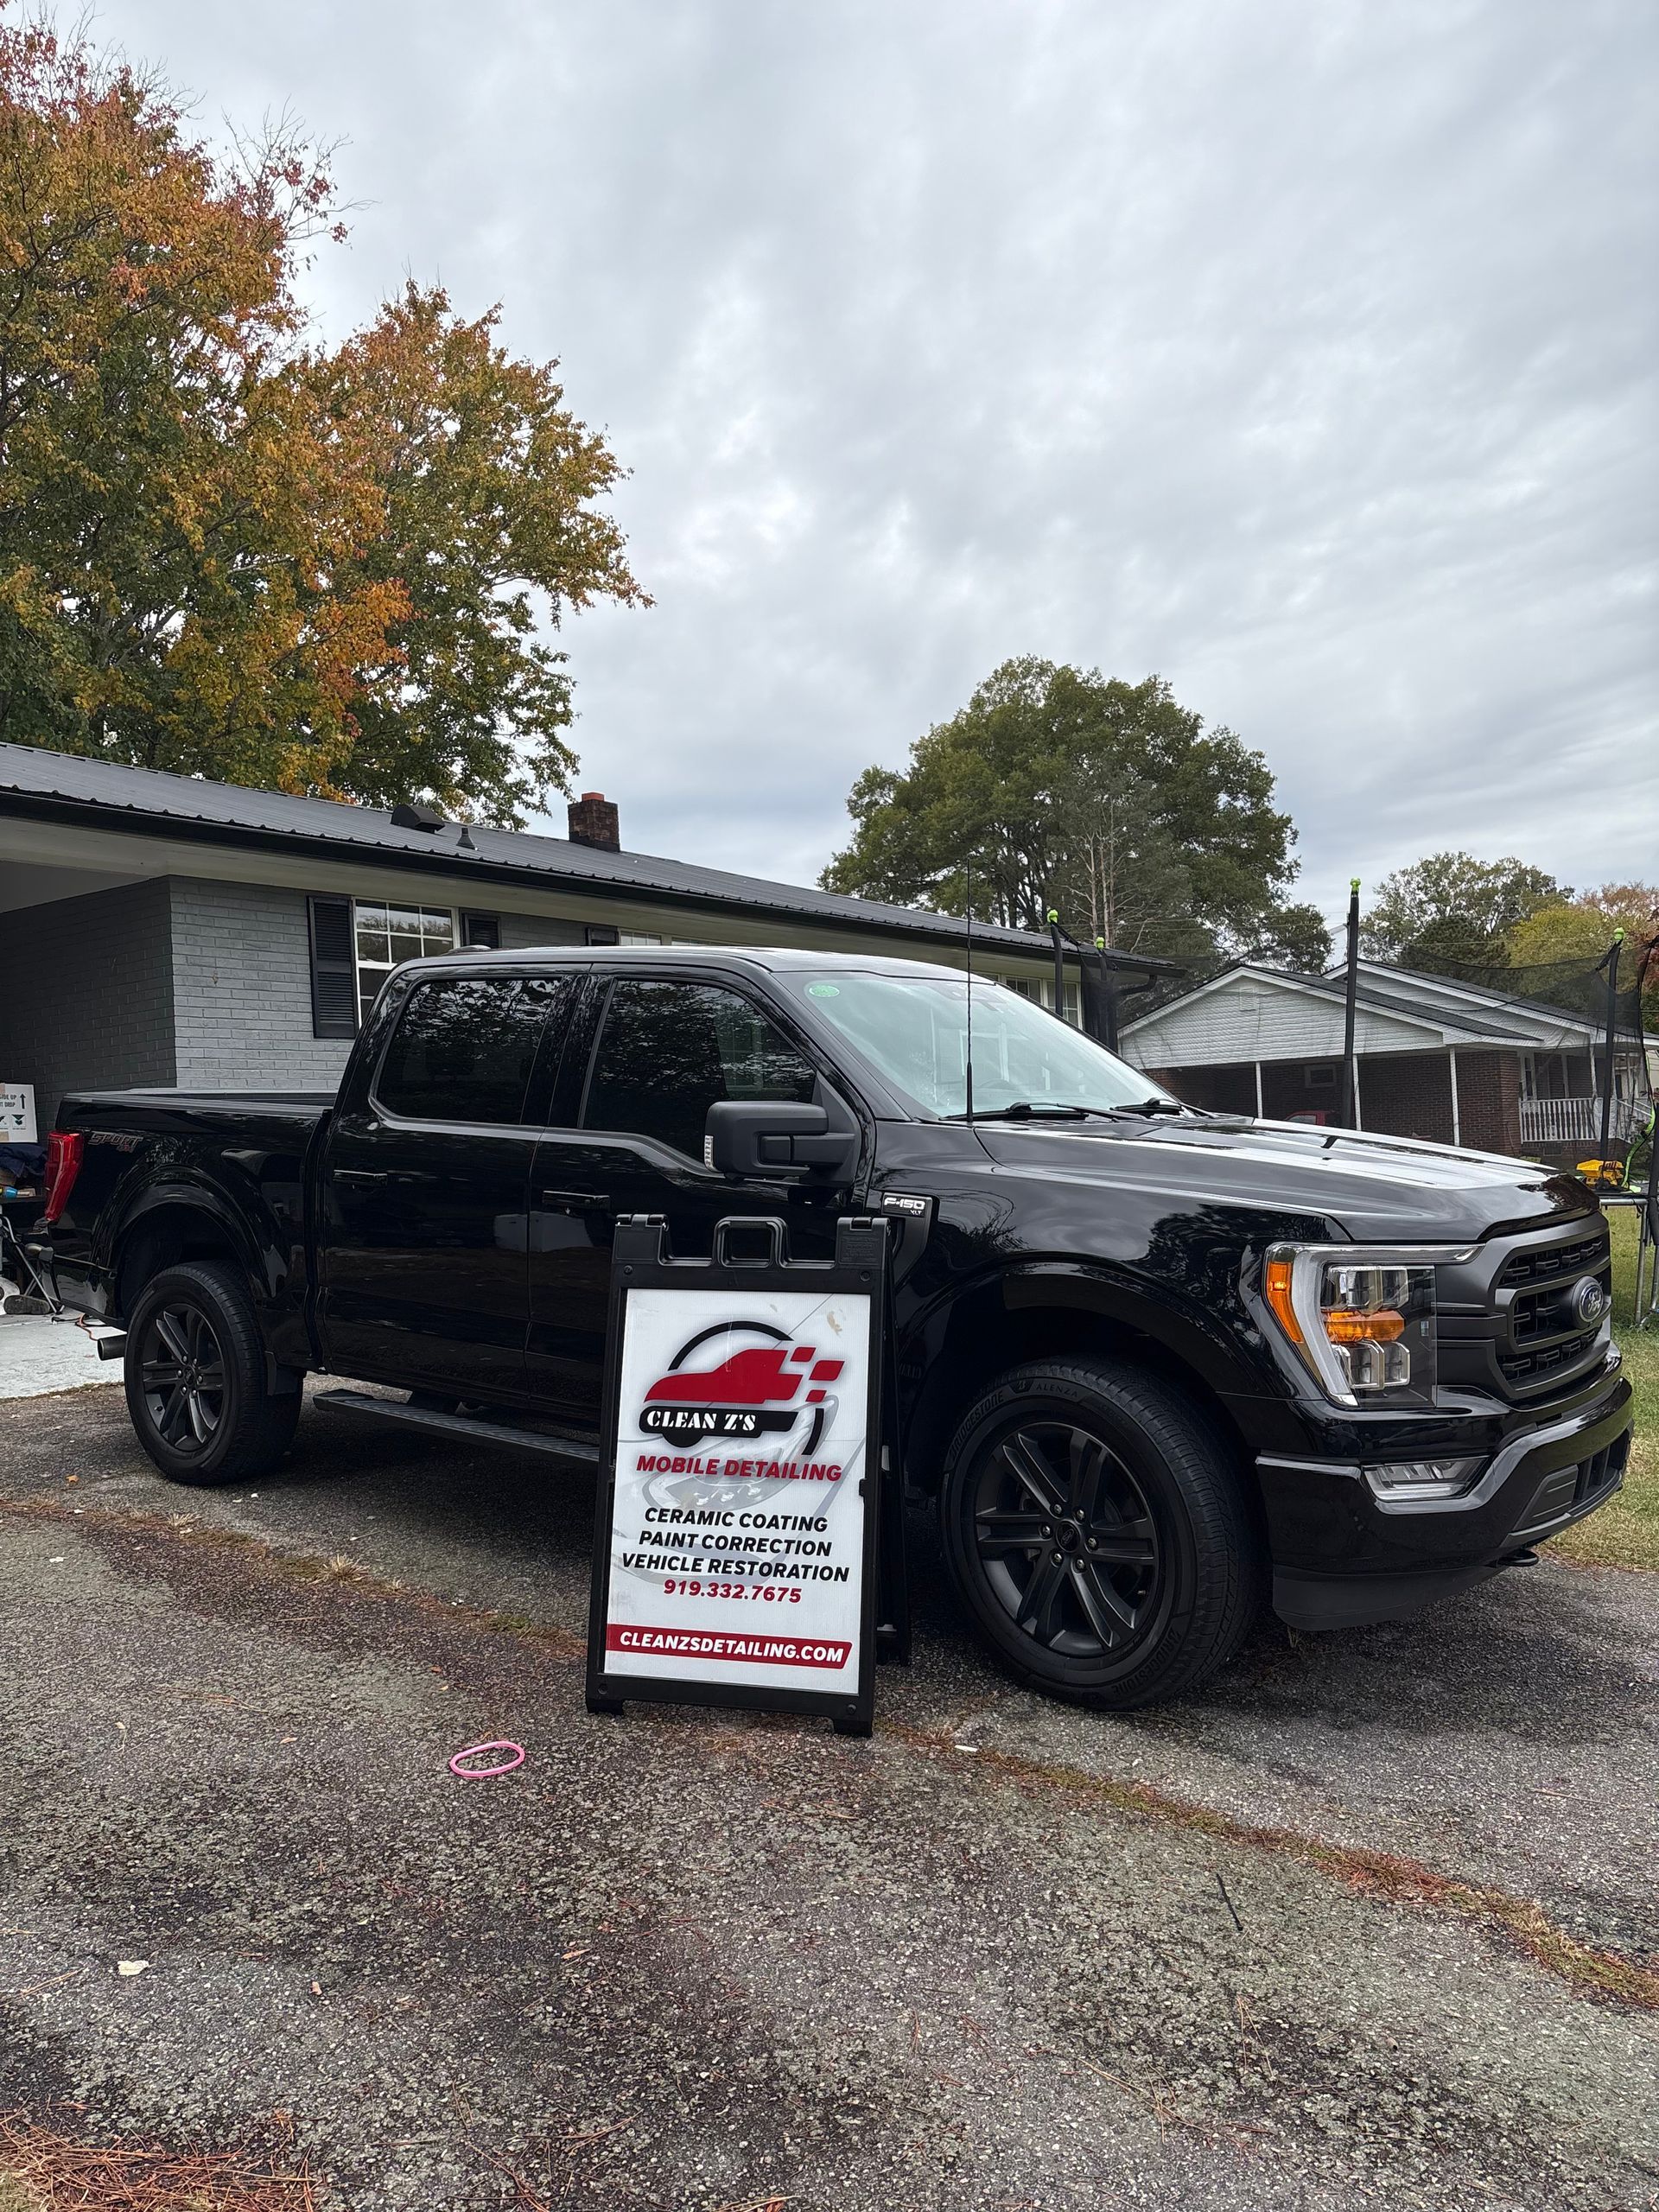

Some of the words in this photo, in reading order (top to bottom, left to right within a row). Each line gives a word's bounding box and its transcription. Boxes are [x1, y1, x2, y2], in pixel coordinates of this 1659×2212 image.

[87, 1133, 144, 1147] SPORT
[884, 1197, 926, 1211] F-150
[1036, 1383, 1077, 1398] ALENZA
[646, 1410, 717, 1431] CLEAN
[722, 1414, 757, 1432] Z'S
[637, 1455, 720, 1476] MOBILE
[723, 1459, 842, 1482] DETAILING
[645, 1507, 735, 1527] CERAMIC
[739, 1512, 828, 1533] COATING
[639, 1530, 699, 1548] PAINT
[702, 1534, 832, 1557] CORRECTION
[622, 1553, 704, 1573] VEHICLE
[707, 1558, 850, 1582] RESTORATION
[664, 1579, 802, 1604] 919.332.7675
[620, 1631, 844, 1663] CLEANZSDETAILING.COM
